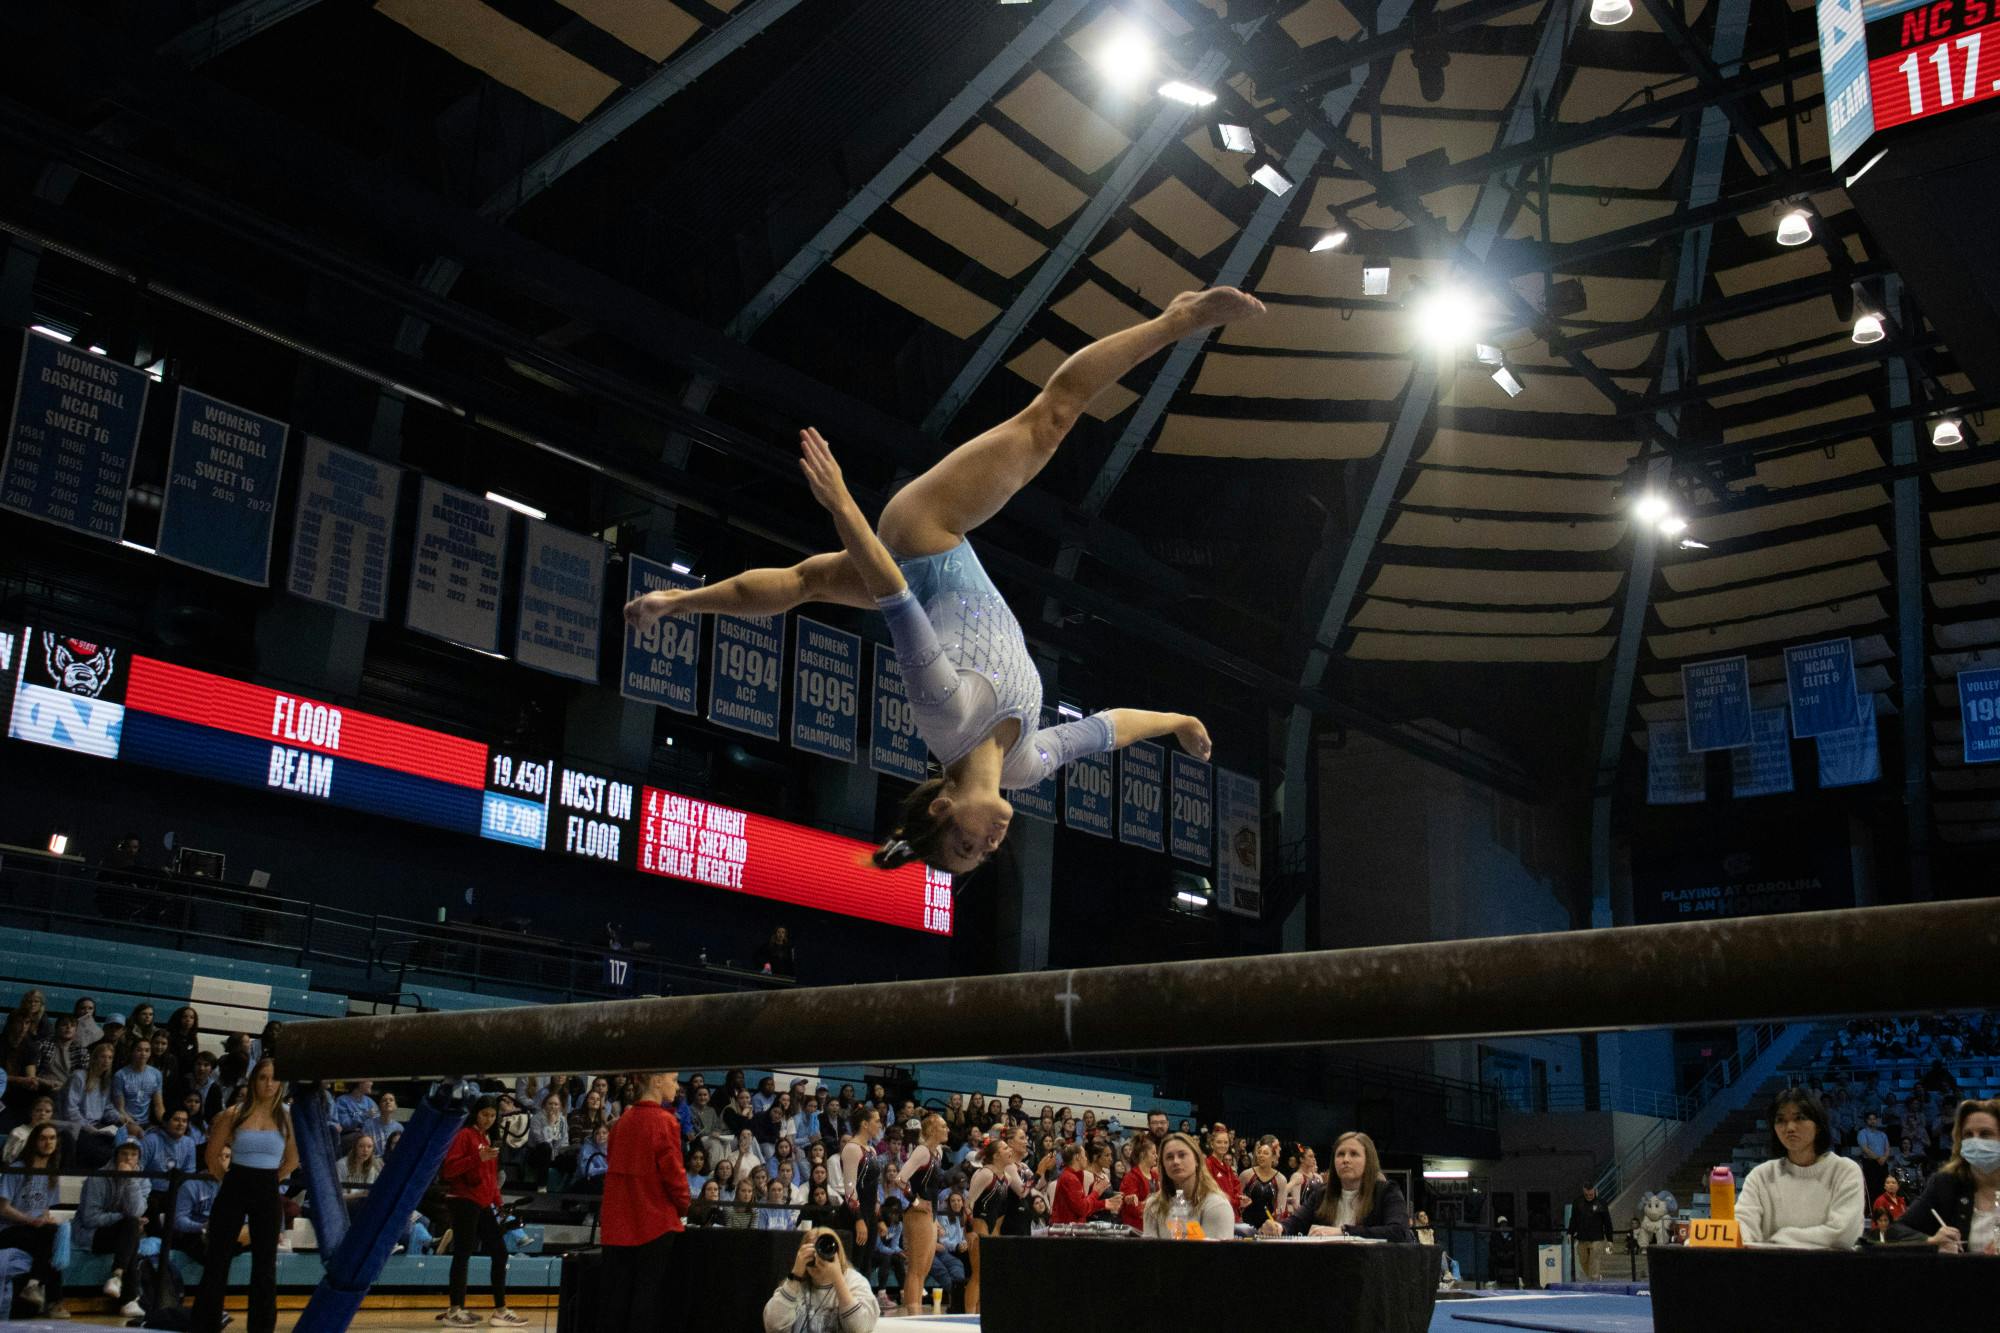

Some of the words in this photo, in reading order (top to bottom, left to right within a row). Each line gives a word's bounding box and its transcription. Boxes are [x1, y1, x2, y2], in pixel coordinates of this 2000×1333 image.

[1964, 0, 2000, 26] S
[1830, 71, 1868, 136] BEAM
[41, 367, 124, 409] BASKETBALL
[61, 394, 98, 420] NCAA
[45, 409, 93, 437] SWEET
[93, 427, 109, 444] 16
[192, 420, 267, 459] BASKETBALL
[209, 446, 244, 470] NCAA
[195, 461, 238, 487] SWEET
[241, 476, 255, 492] 16
[720, 620, 778, 653] BASKETBALL
[718, 641, 777, 693] 1994
[800, 648, 854, 679] BASKETBALL
[1791, 644, 1845, 662] VOLLEYBALL
[1804, 658, 1834, 673] NCAA
[651, 658, 672, 677] ACC
[1803, 673, 1830, 688] ELITE
[1832, 671, 1840, 683] 8
[629, 672, 691, 703] CHAMPIONS
[736, 685, 756, 704] ACC
[799, 669, 856, 717] 1995
[1695, 684, 1727, 697] SWEET
[272, 695, 342, 750] FLOOR
[716, 698, 774, 728] CHAMPIONS
[815, 711, 835, 729] ACC
[878, 696, 919, 738] 199
[798, 724, 851, 752] CHAMPIONS
[891, 734, 909, 752] ACC
[268, 746, 334, 798] BEAM
[875, 746, 925, 774] CHAMPIONS
[1124, 761, 1160, 782] BASKETBALL
[493, 754, 545, 795] 19.450
[1068, 759, 1110, 798] 2006
[1175, 777, 1209, 799] BASKETBALL
[560, 769, 606, 814] NCST
[608, 781, 633, 820] ON
[1083, 794, 1096, 808] ACC
[1124, 777, 1161, 813] 2007
[489, 800, 542, 840] 19.200
[648, 791, 659, 817] 4.
[662, 794, 705, 827] ASHLEY
[706, 804, 747, 837] KNIGHT
[1069, 806, 1108, 829] CHAMPIONS
[1136, 810, 1149, 825] ACC
[1174, 793, 1209, 829] 2008
[566, 815, 620, 862] FLOOR
[646, 816, 658, 843] 5.
[660, 820, 697, 852] EMILY
[698, 829, 748, 863] SHEPARD
[1124, 822, 1160, 843] CHAMPIONS
[1186, 826, 1198, 839] ACC
[1175, 838, 1209, 858] CHAMPIONS
[644, 843, 655, 870] 6.
[658, 846, 694, 878] CHLOE
[696, 854, 744, 888] NEGRETE
[925, 883, 951, 910] 0.000
[1661, 887, 1721, 902] PLAYING
[1724, 884, 1741, 897] AT
[1745, 877, 1823, 895] CAROLINA
[924, 906, 950, 933] 0.000
[1679, 902, 1691, 913] IS
[1694, 900, 1716, 912] AN
[609, 958, 627, 985] 117
[1695, 1224, 1734, 1242] UTL
